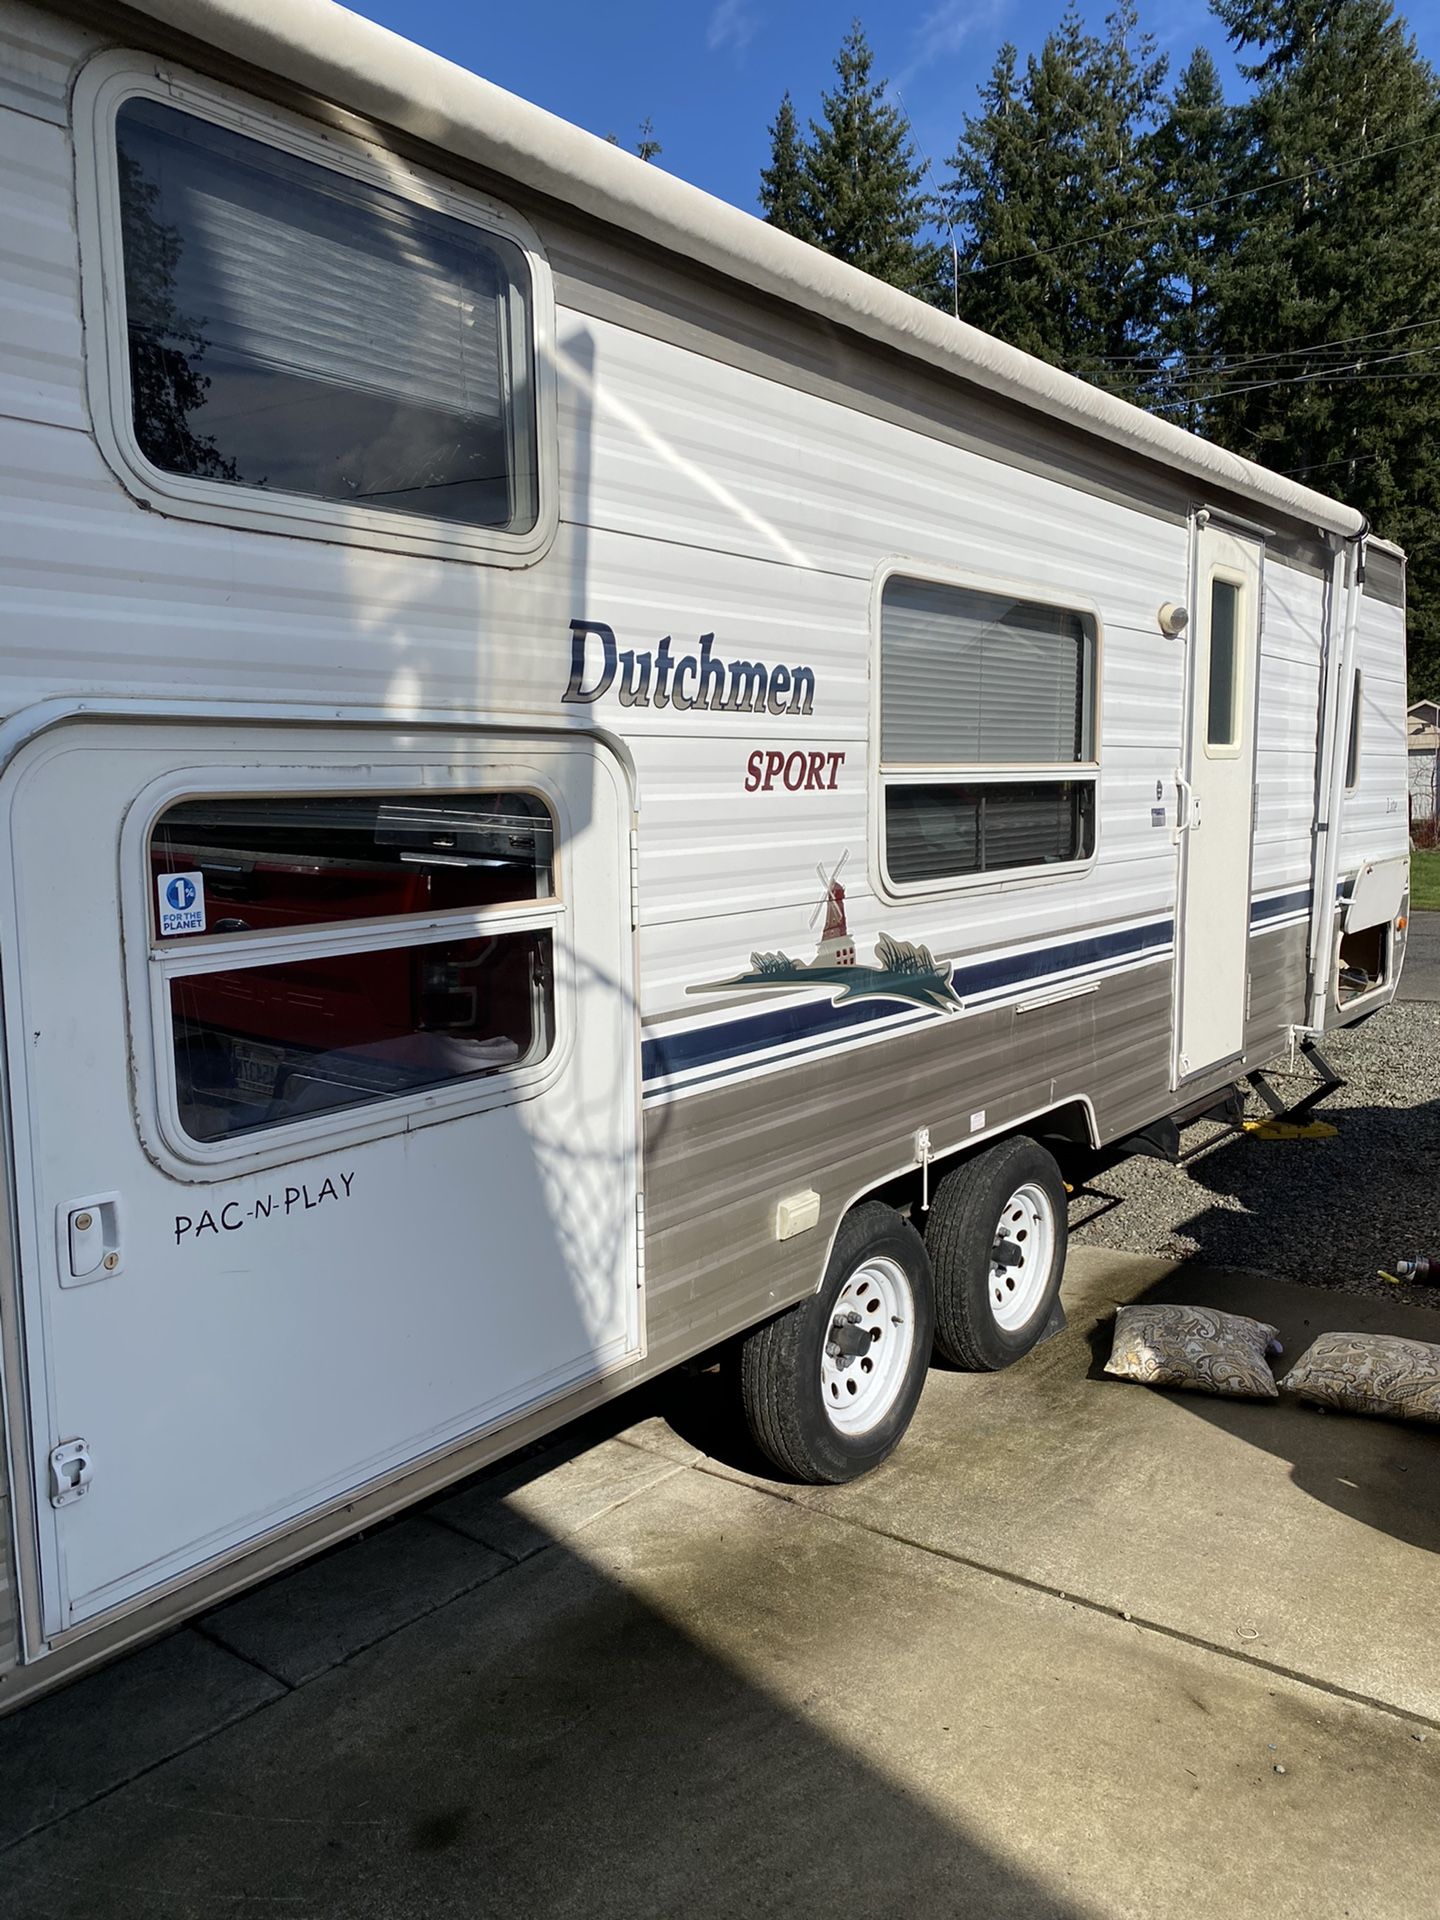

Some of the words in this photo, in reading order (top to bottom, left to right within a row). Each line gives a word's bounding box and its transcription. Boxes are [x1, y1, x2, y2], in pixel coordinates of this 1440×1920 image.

[561, 619, 815, 715] Dutchmen
[744, 750, 845, 792] SPORT
[163, 913, 183, 922] FOR
[184, 911, 202, 920] THE
[163, 919, 202, 931] PLANET
[175, 1172, 355, 1245] PAC-N-PLAY
